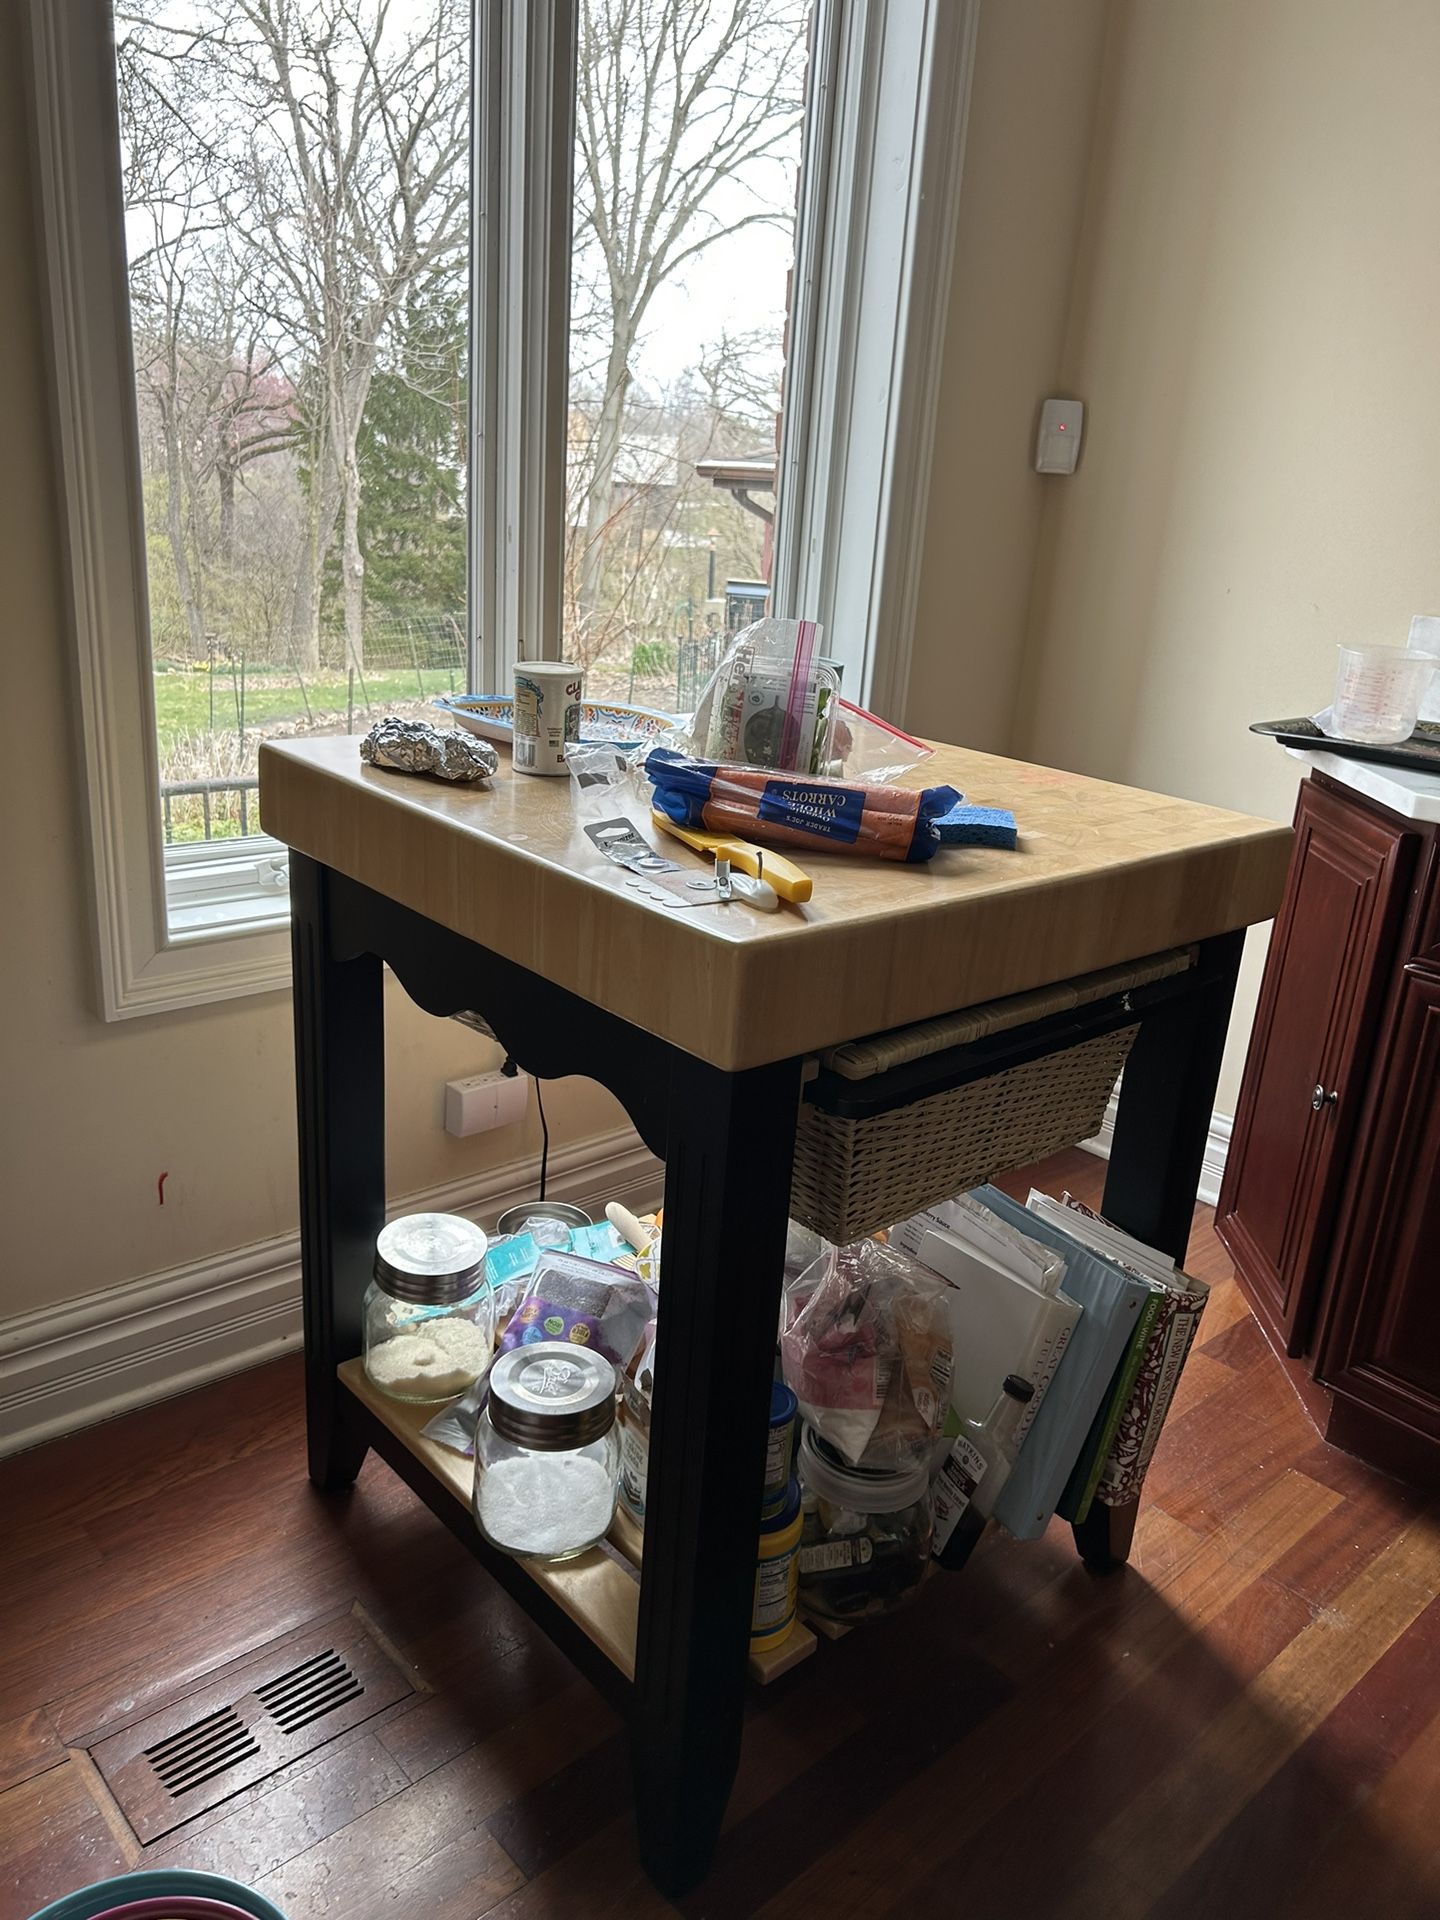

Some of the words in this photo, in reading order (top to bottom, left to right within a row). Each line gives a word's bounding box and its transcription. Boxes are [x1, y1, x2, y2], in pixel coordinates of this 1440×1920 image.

[782, 789, 847, 807] CARROTS
[787, 801, 837, 818] WHOLE
[785, 815, 804, 825] JOE'S
[805, 820, 831, 833] TRADER
[1146, 1298, 1159, 1322] FOOD
[1136, 1327, 1150, 1350] WINE
[1177, 1318, 1190, 1341] THE
[1048, 1327, 1071, 1369] GREAT
[1170, 1342, 1184, 1361] NEW
[1161, 1360, 1178, 1390] BASICS
[957, 1439, 984, 1470] WATKINS
